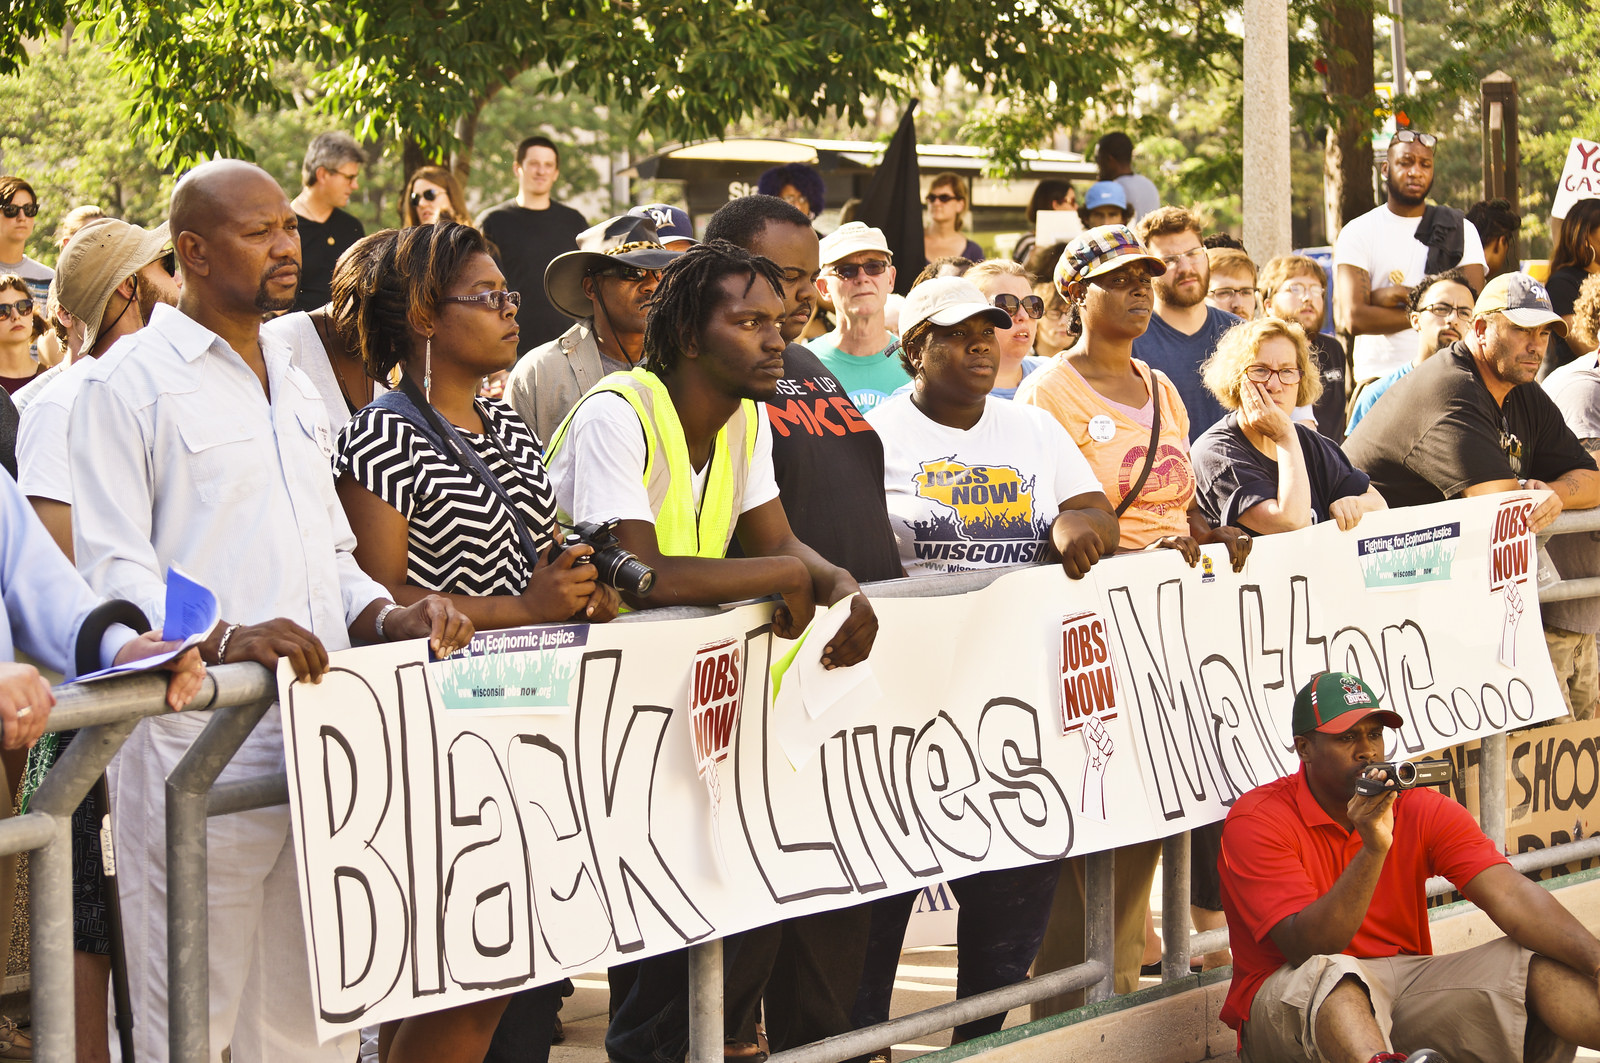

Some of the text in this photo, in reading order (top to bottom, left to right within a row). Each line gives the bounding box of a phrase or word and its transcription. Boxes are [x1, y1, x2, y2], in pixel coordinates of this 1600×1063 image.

[813, 376, 837, 393] UP
[765, 396, 875, 437] MKE
[924, 467, 990, 488] JOBS
[952, 481, 1018, 505] NOW
[1364, 526, 1452, 554] Fighting for Economic Justice
[1493, 503, 1532, 545] JOBS
[1493, 539, 1528, 583] NOW
[471, 636, 485, 653] for
[486, 631, 538, 651] Economic
[539, 629, 575, 646] Justice
[1062, 620, 1107, 673] JOBS
[692, 648, 740, 710] JOBS
[1064, 666, 1116, 721] NOW
[693, 700, 737, 763] NOW
[288, 649, 716, 1022] Black
